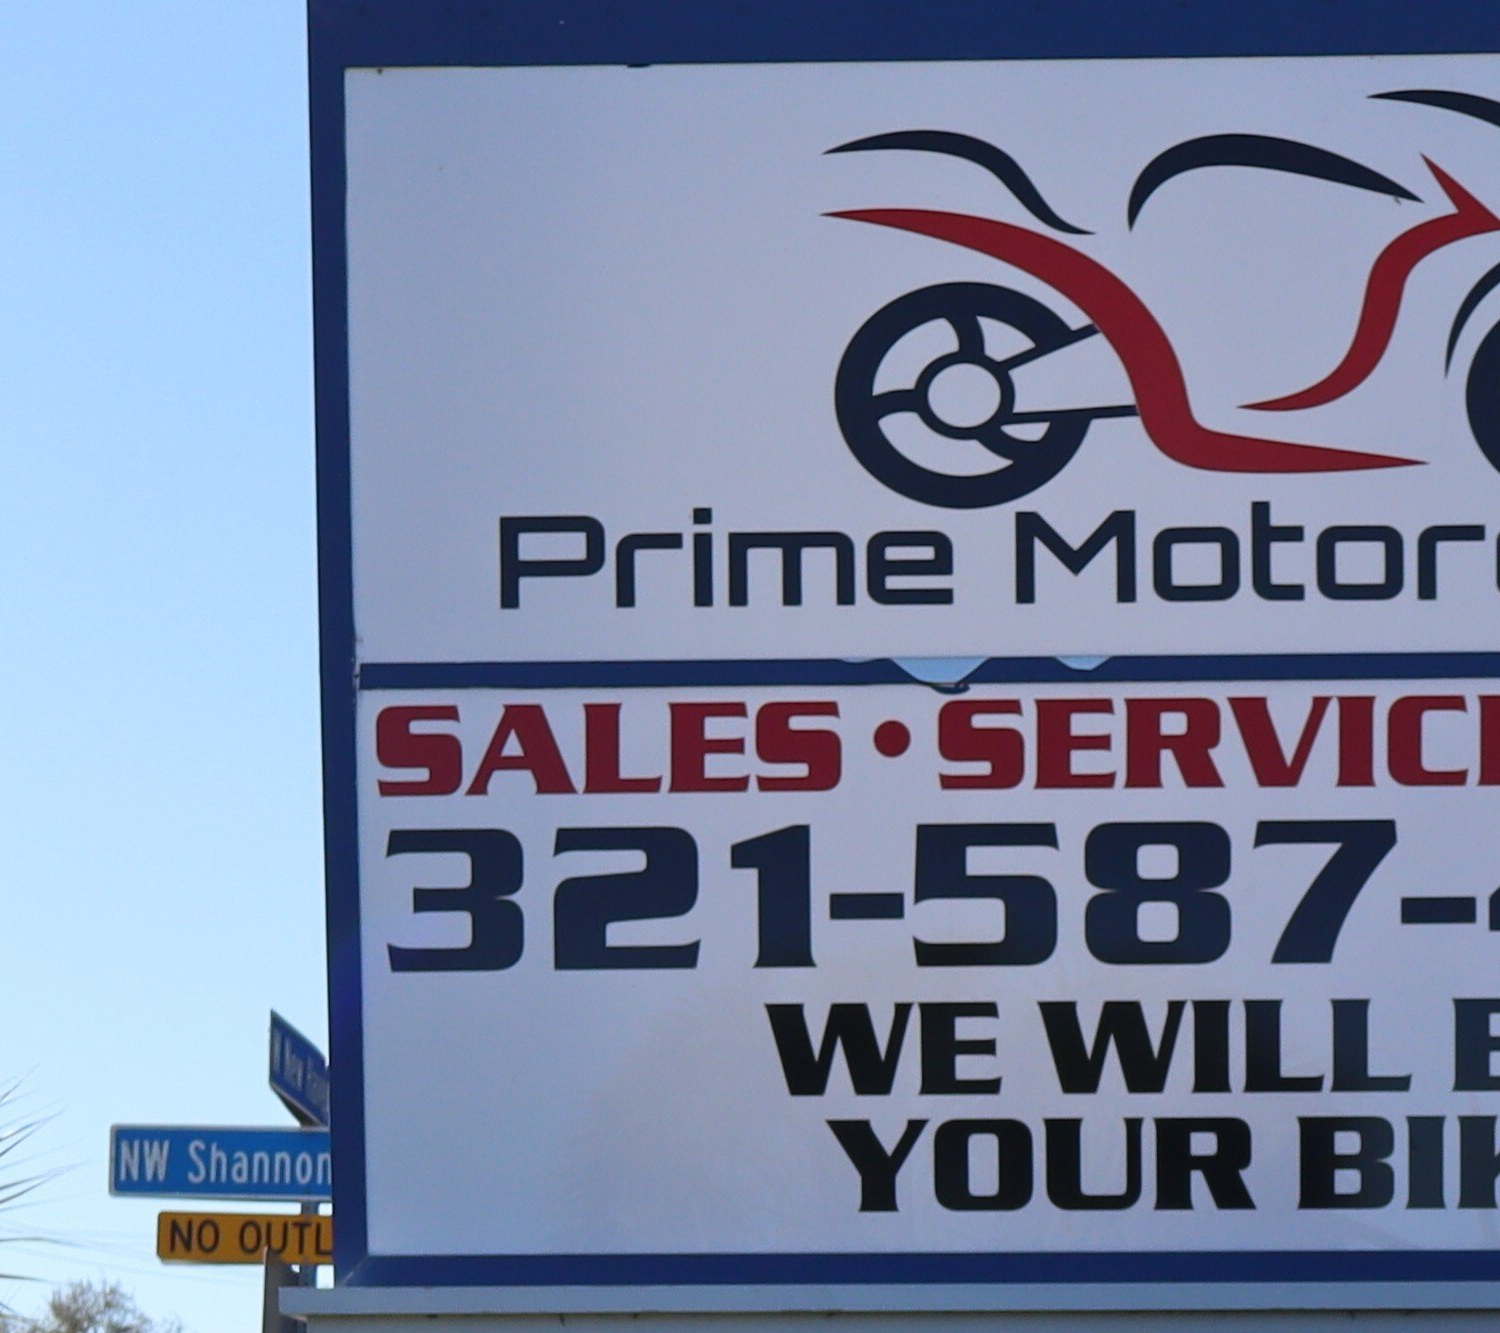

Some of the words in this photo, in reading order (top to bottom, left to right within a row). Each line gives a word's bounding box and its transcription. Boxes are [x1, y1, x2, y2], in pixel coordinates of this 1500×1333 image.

[500, 507, 953, 610] Prime
[375, 701, 841, 796] SALES
[764, 1001, 1002, 1097] WE
[1036, 998, 1412, 1095] WILL
[119, 1139, 170, 1182] NW
[187, 1139, 332, 1184] Shannon
[826, 1116, 1257, 1213] YOUR
[169, 1218, 220, 1255] NO
